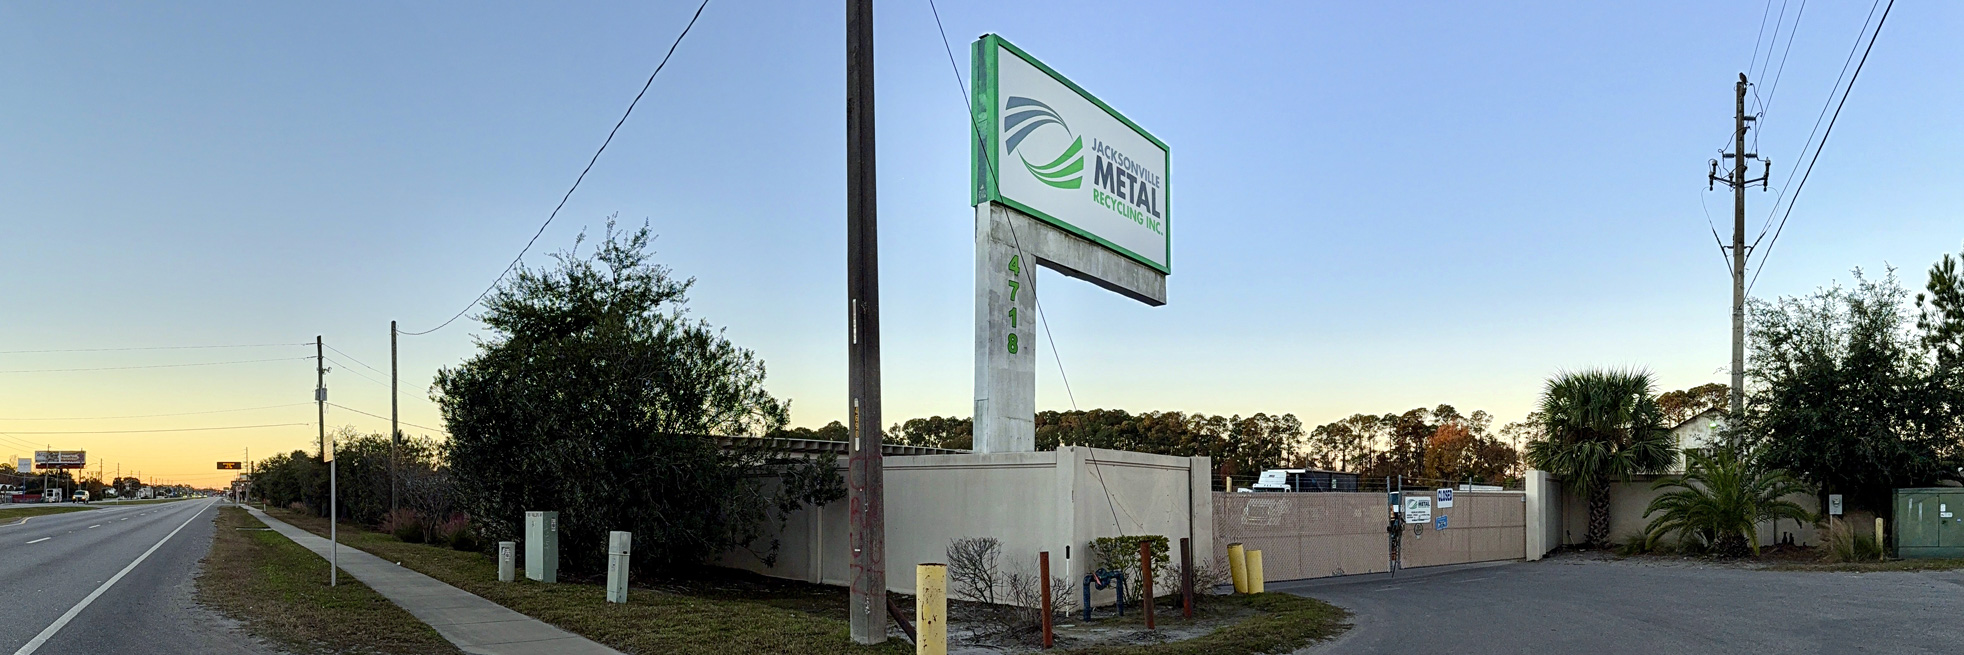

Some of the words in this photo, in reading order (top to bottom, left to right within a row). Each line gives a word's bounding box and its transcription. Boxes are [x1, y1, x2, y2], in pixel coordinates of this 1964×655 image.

[1091, 138, 1160, 189] JACKSONVILLE
[1094, 154, 1161, 219] METAL
[1093, 188, 1144, 226] RECYCLING
[1146, 216, 1164, 236] INC.
[1007, 254, 1020, 355] 4718
[1437, 489, 1453, 502] CLOSED
